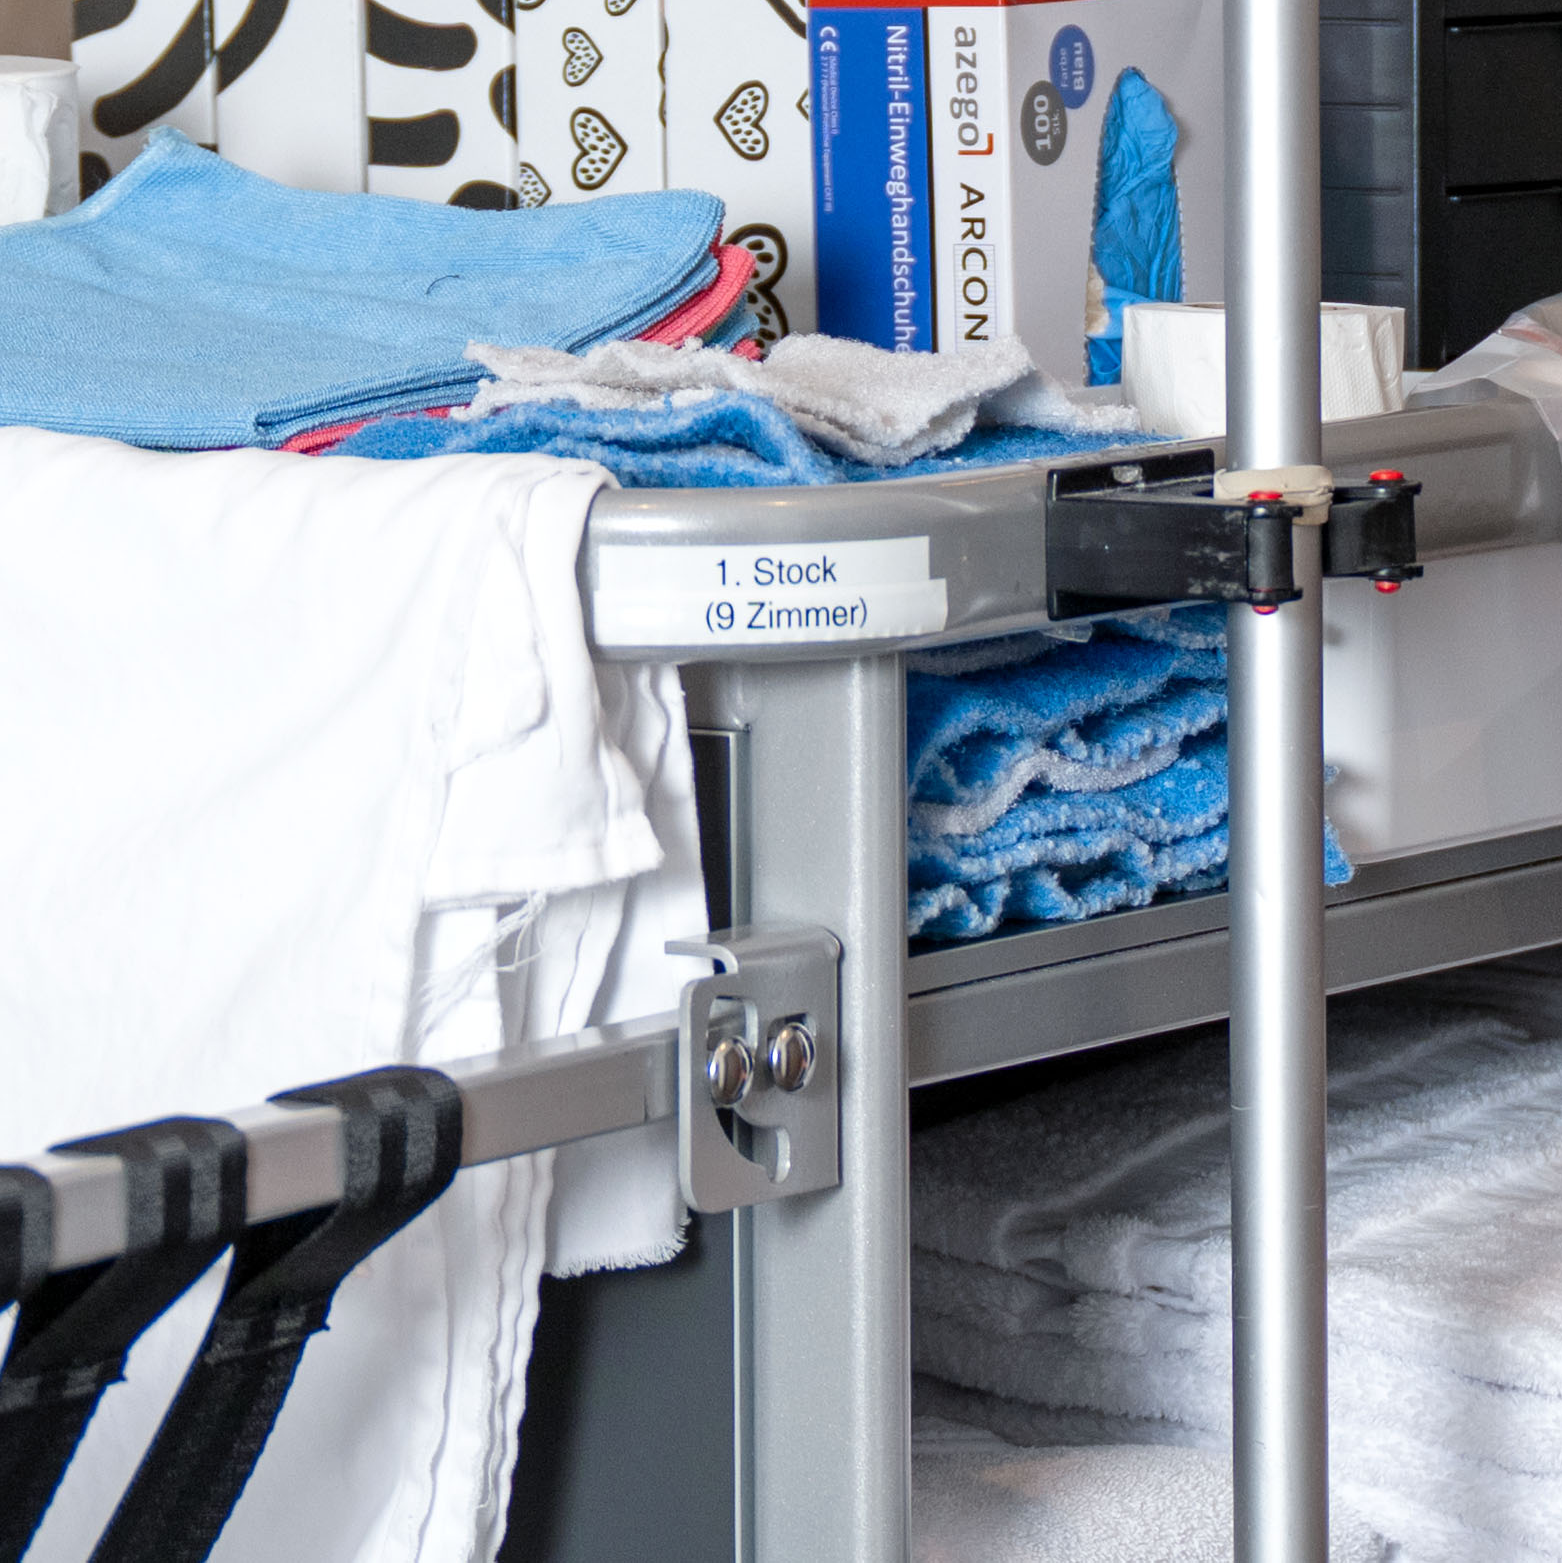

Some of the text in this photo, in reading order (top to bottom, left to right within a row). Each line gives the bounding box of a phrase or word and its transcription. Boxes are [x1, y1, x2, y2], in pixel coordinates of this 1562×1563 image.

[1059, 48, 1068, 88] Farbe
[1072, 42, 1085, 90] Blau
[1034, 94, 1051, 151] 100
[959, 183, 990, 341] ARCON
[716, 555, 837, 587] 1. Stock
[705, 596, 868, 633] (9 Zimmer)
